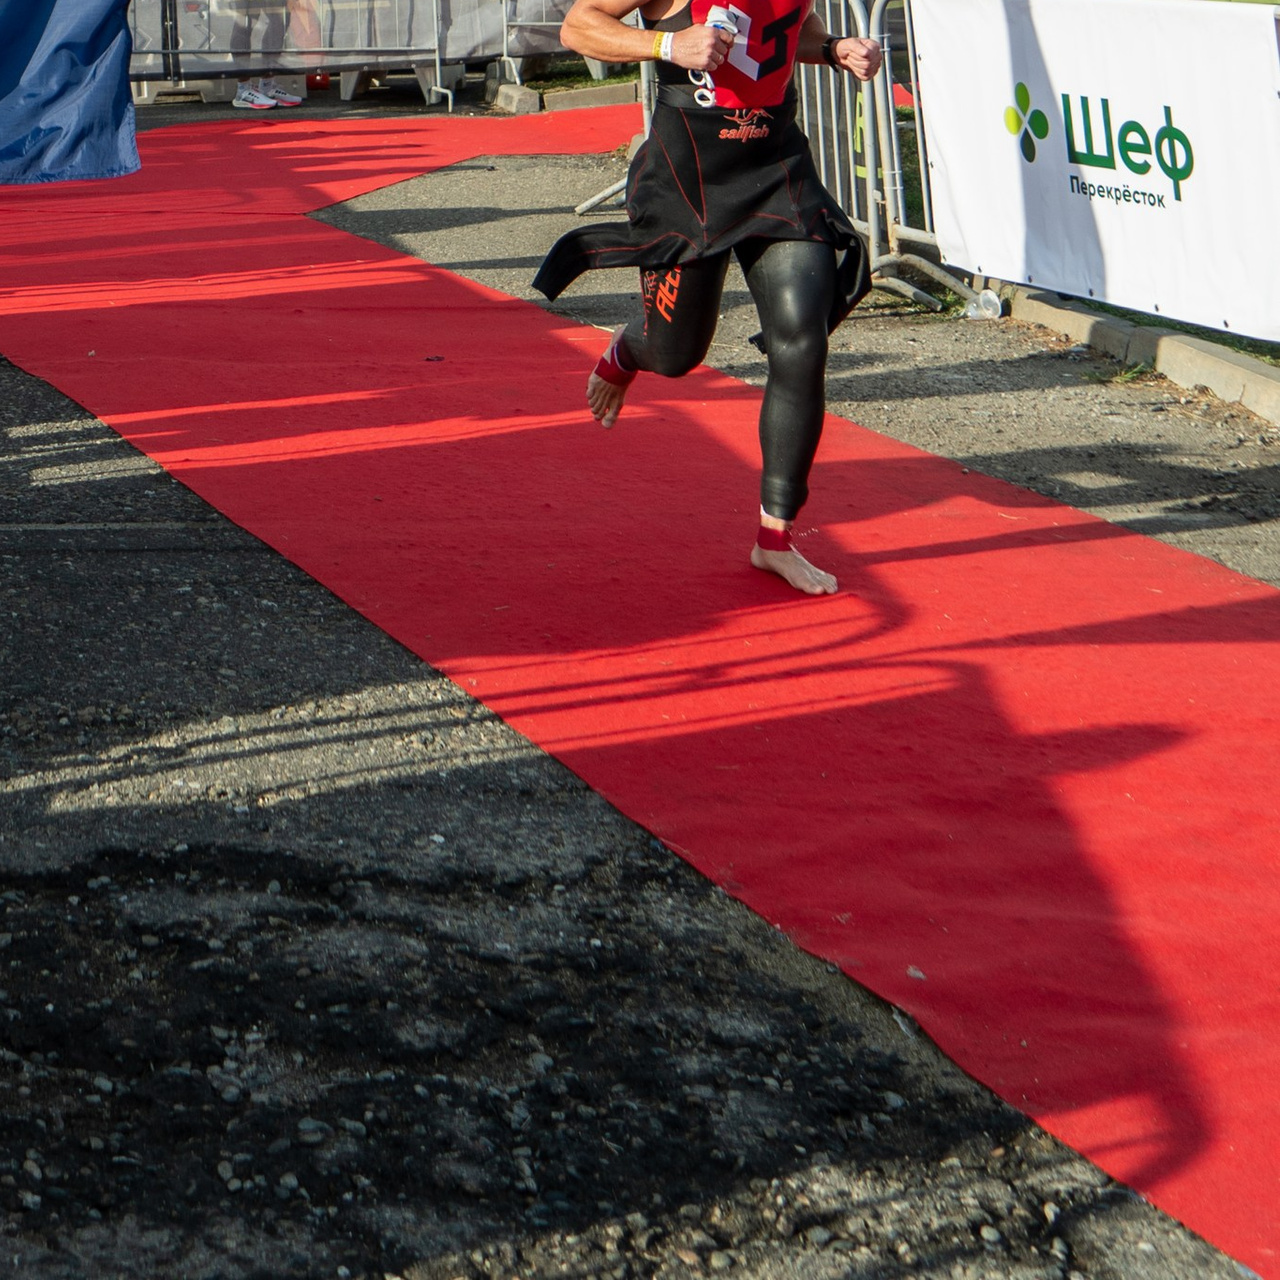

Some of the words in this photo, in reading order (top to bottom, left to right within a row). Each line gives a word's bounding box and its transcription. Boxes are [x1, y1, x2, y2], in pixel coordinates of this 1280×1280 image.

[718, 124, 770, 143] sailfish
[1061, 93, 1194, 202] Шеф
[1070, 175, 1166, 209] Перекрёсток
